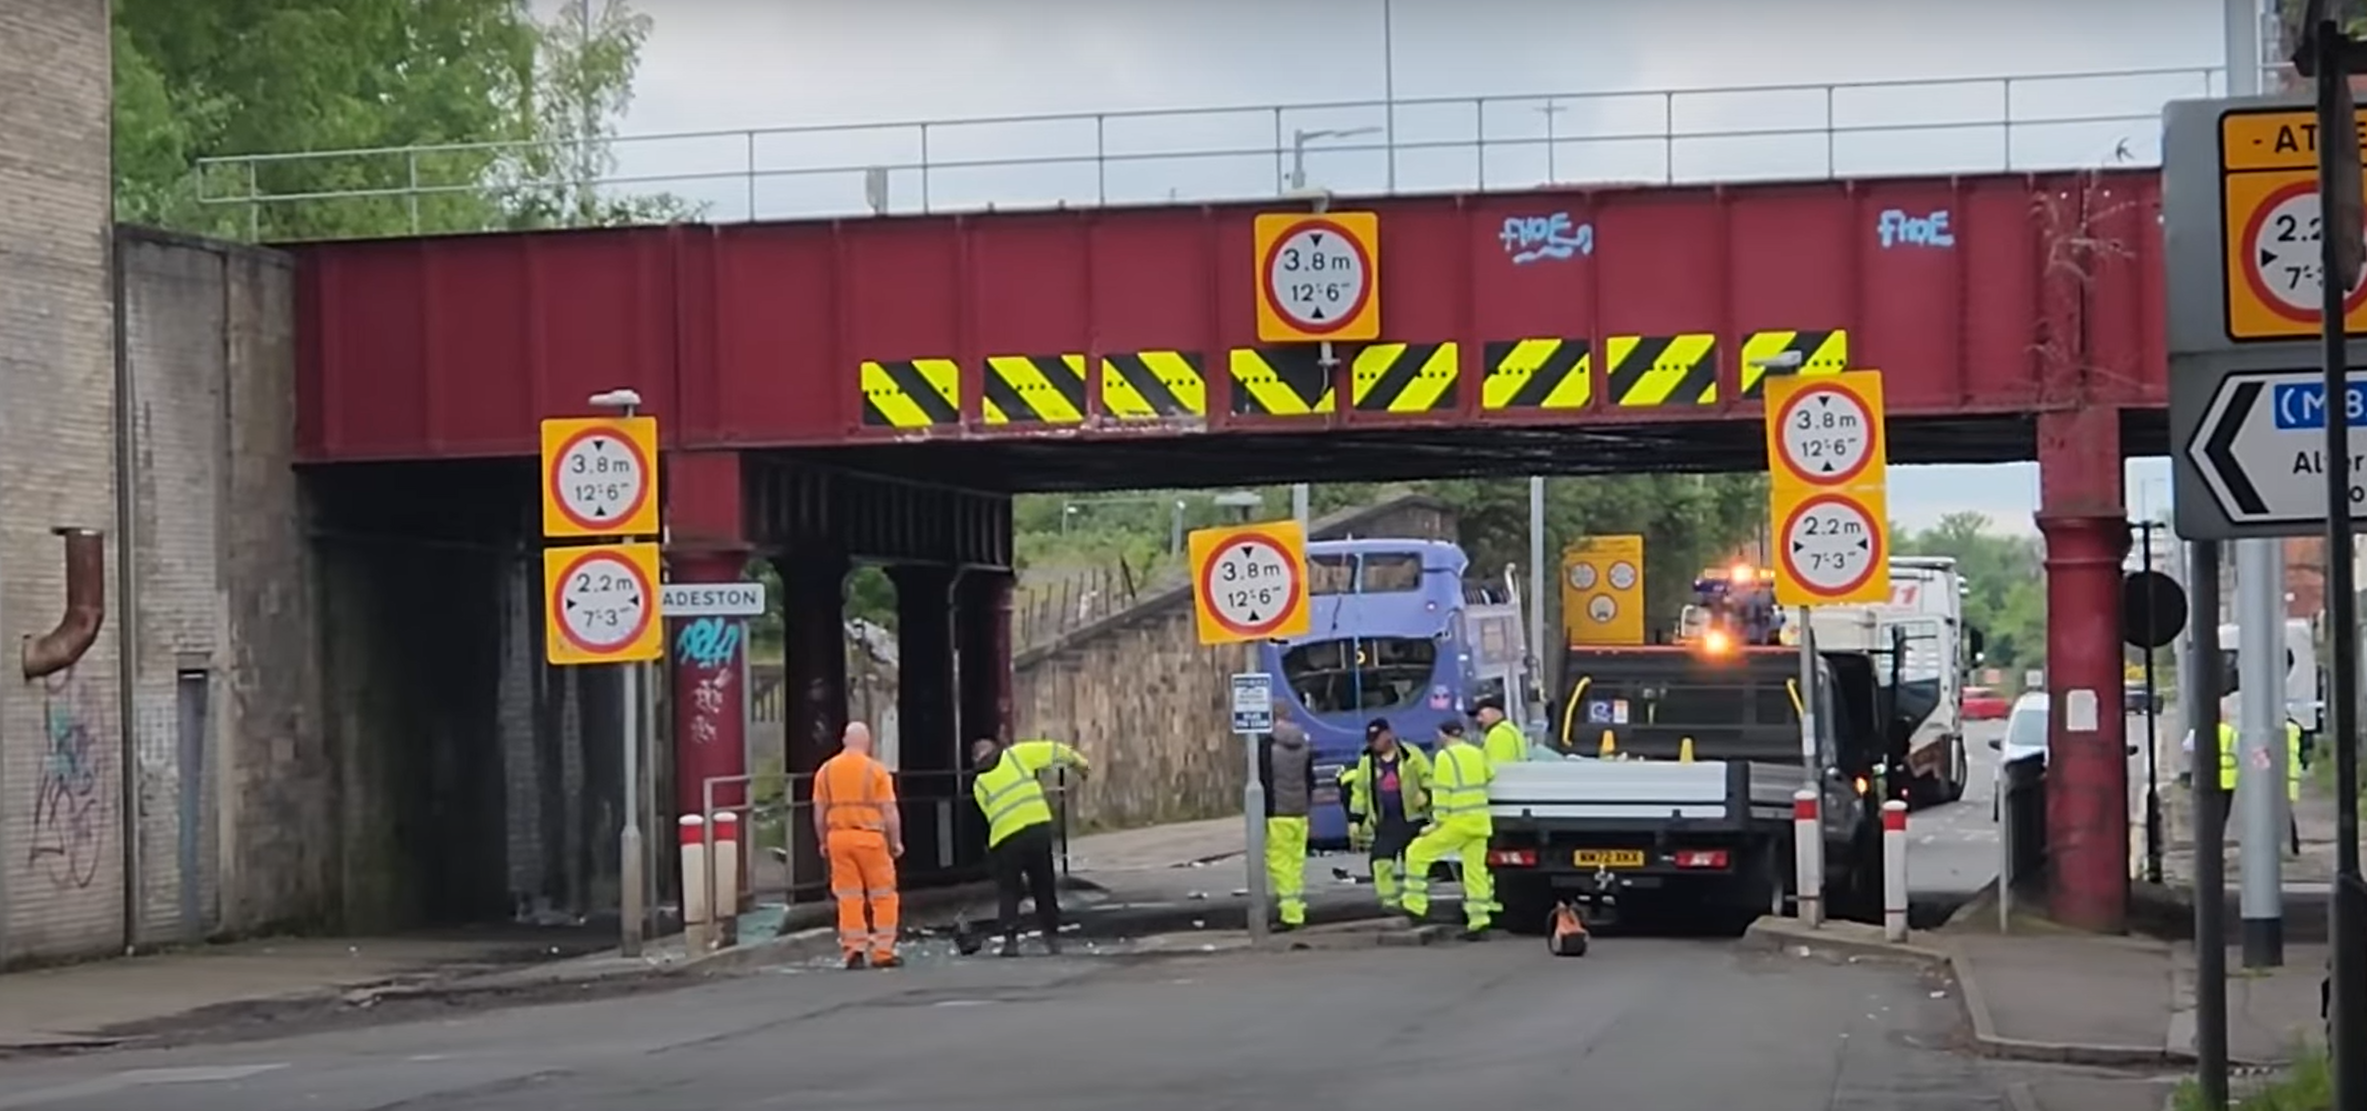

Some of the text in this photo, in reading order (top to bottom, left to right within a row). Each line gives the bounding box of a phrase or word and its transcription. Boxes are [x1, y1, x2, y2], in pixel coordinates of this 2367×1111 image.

[1283, 248, 1351, 272] 3.8 m
[1797, 410, 1857, 429] 3.8 m
[571, 454, 630, 474] 3.8 m
[1804, 516, 1861, 535] 2.2 m
[1222, 561, 1280, 581] 3.8 m
[576, 573, 633, 593] 2.2 m
